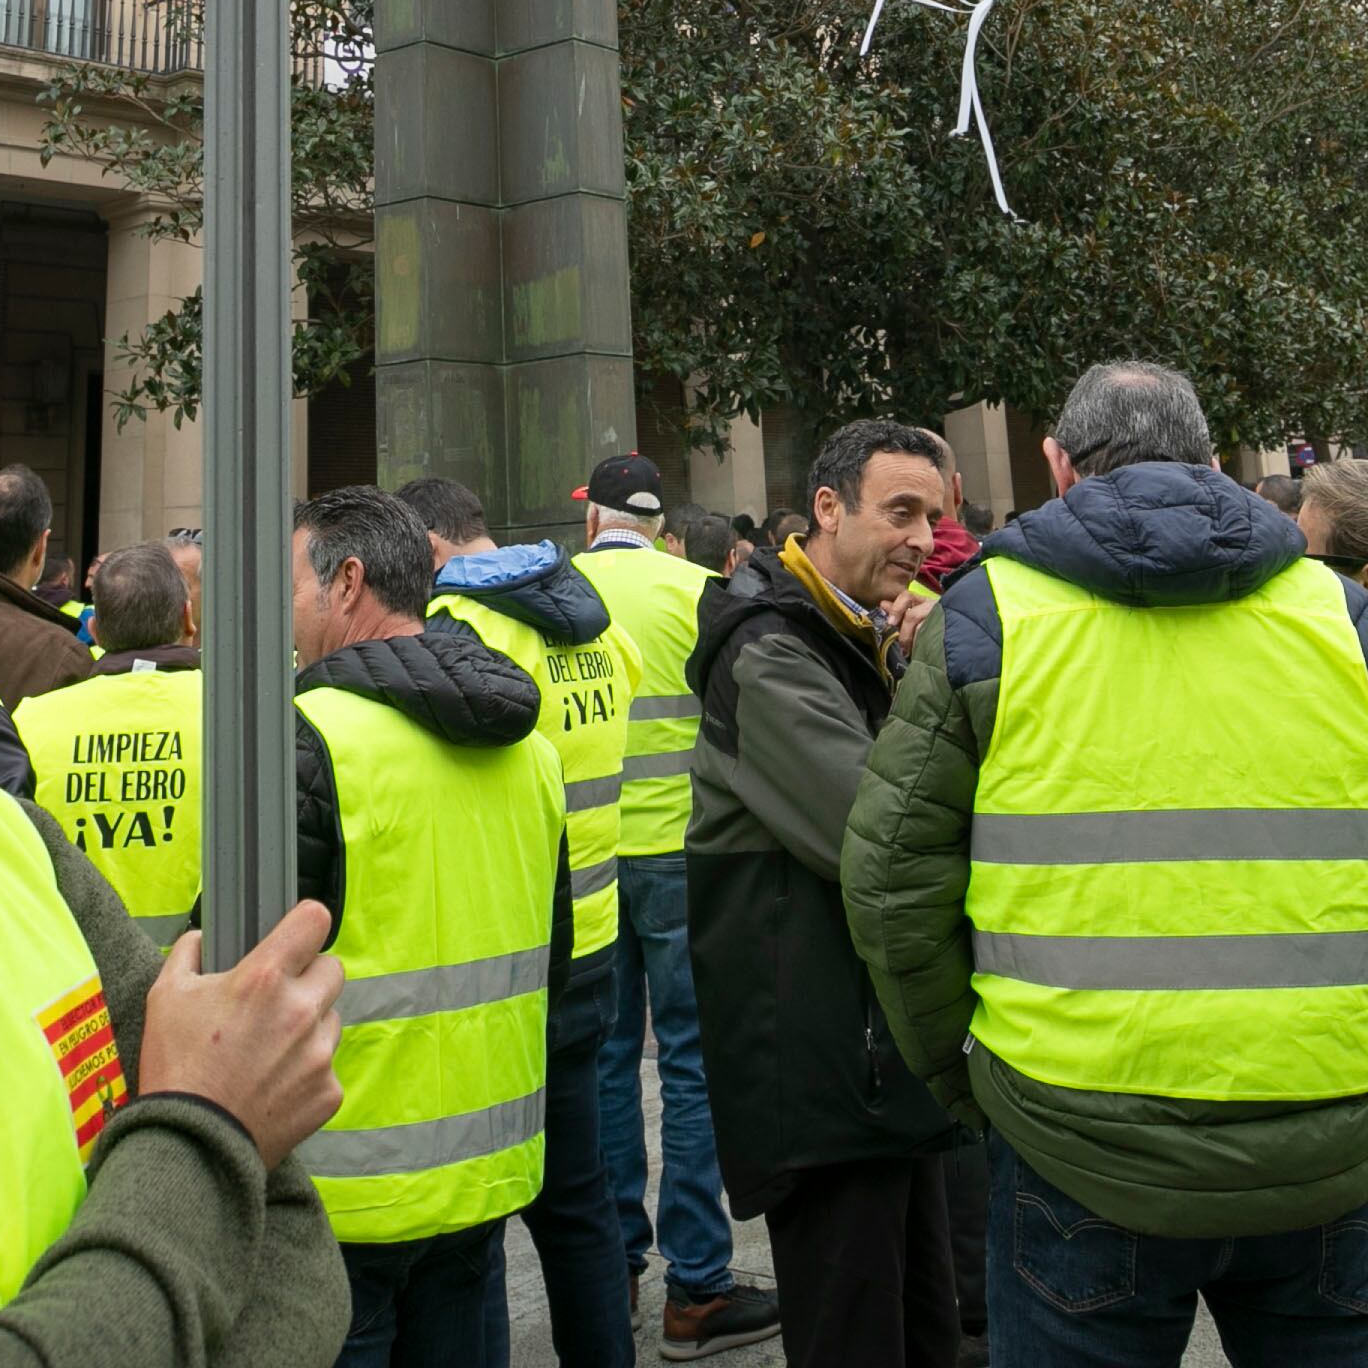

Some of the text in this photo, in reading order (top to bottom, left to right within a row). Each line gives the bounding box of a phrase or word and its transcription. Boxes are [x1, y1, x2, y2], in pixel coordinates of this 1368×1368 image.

[547, 651, 614, 683] DEL EBRO
[563, 683, 615, 732] ¡YA!
[73, 731, 183, 764] LIMPIEZA
[66, 768, 186, 803] DEL EBRO
[76, 806, 175, 853] ¡YA!
